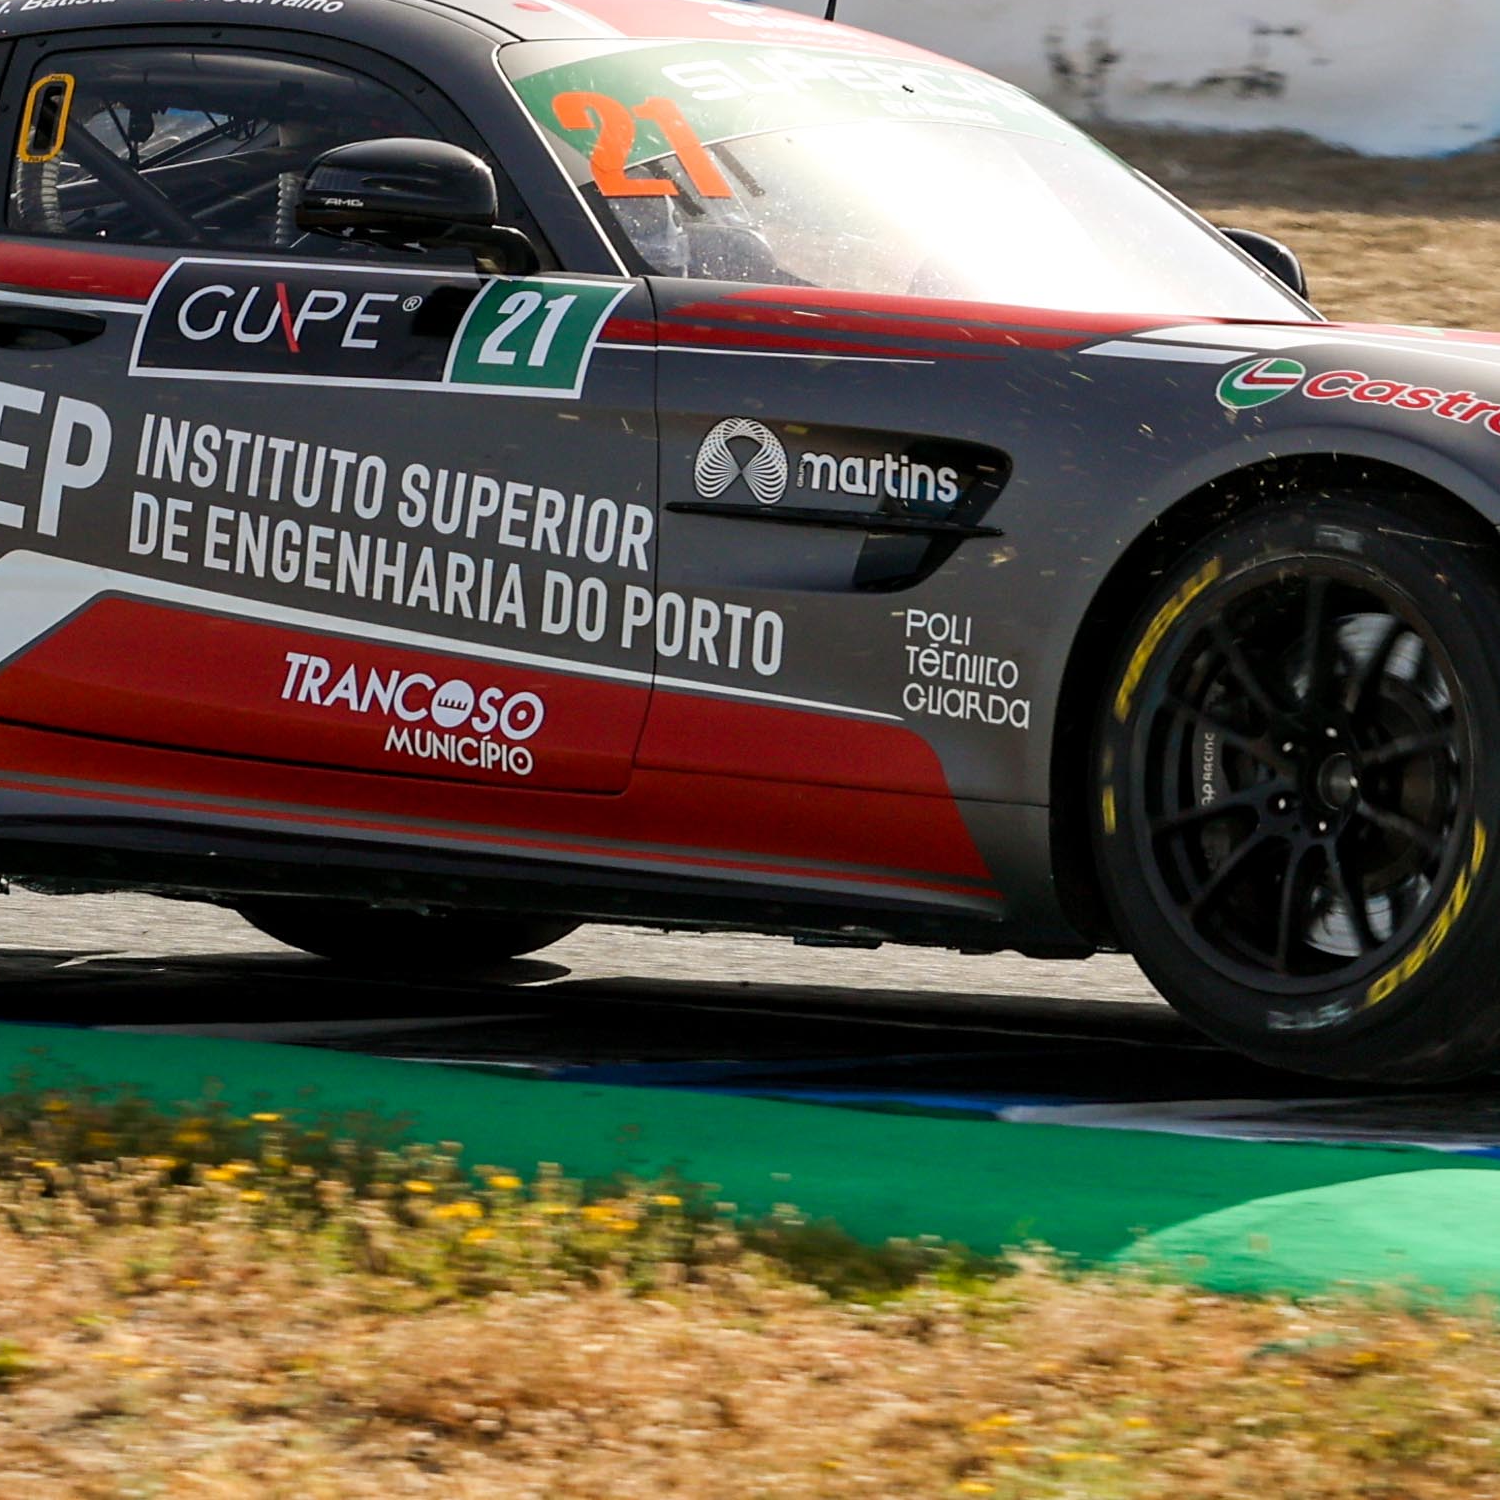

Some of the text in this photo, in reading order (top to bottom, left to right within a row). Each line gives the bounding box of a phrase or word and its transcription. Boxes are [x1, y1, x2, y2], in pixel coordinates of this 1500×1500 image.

[552, 90, 732, 198] 21
[325, 198, 364, 207] AMG
[477, 291, 577, 367] 21
[136, 413, 654, 571] INSTITUTO SUPERIOR
[801, 451, 959, 503] martins
[128, 490, 784, 677] DE ENGENHARIA DO PORTO
[905, 609, 972, 646] POLI
[281, 652, 544, 741] TRANCOSO
[384, 725, 534, 776] MUNICÍPIO
